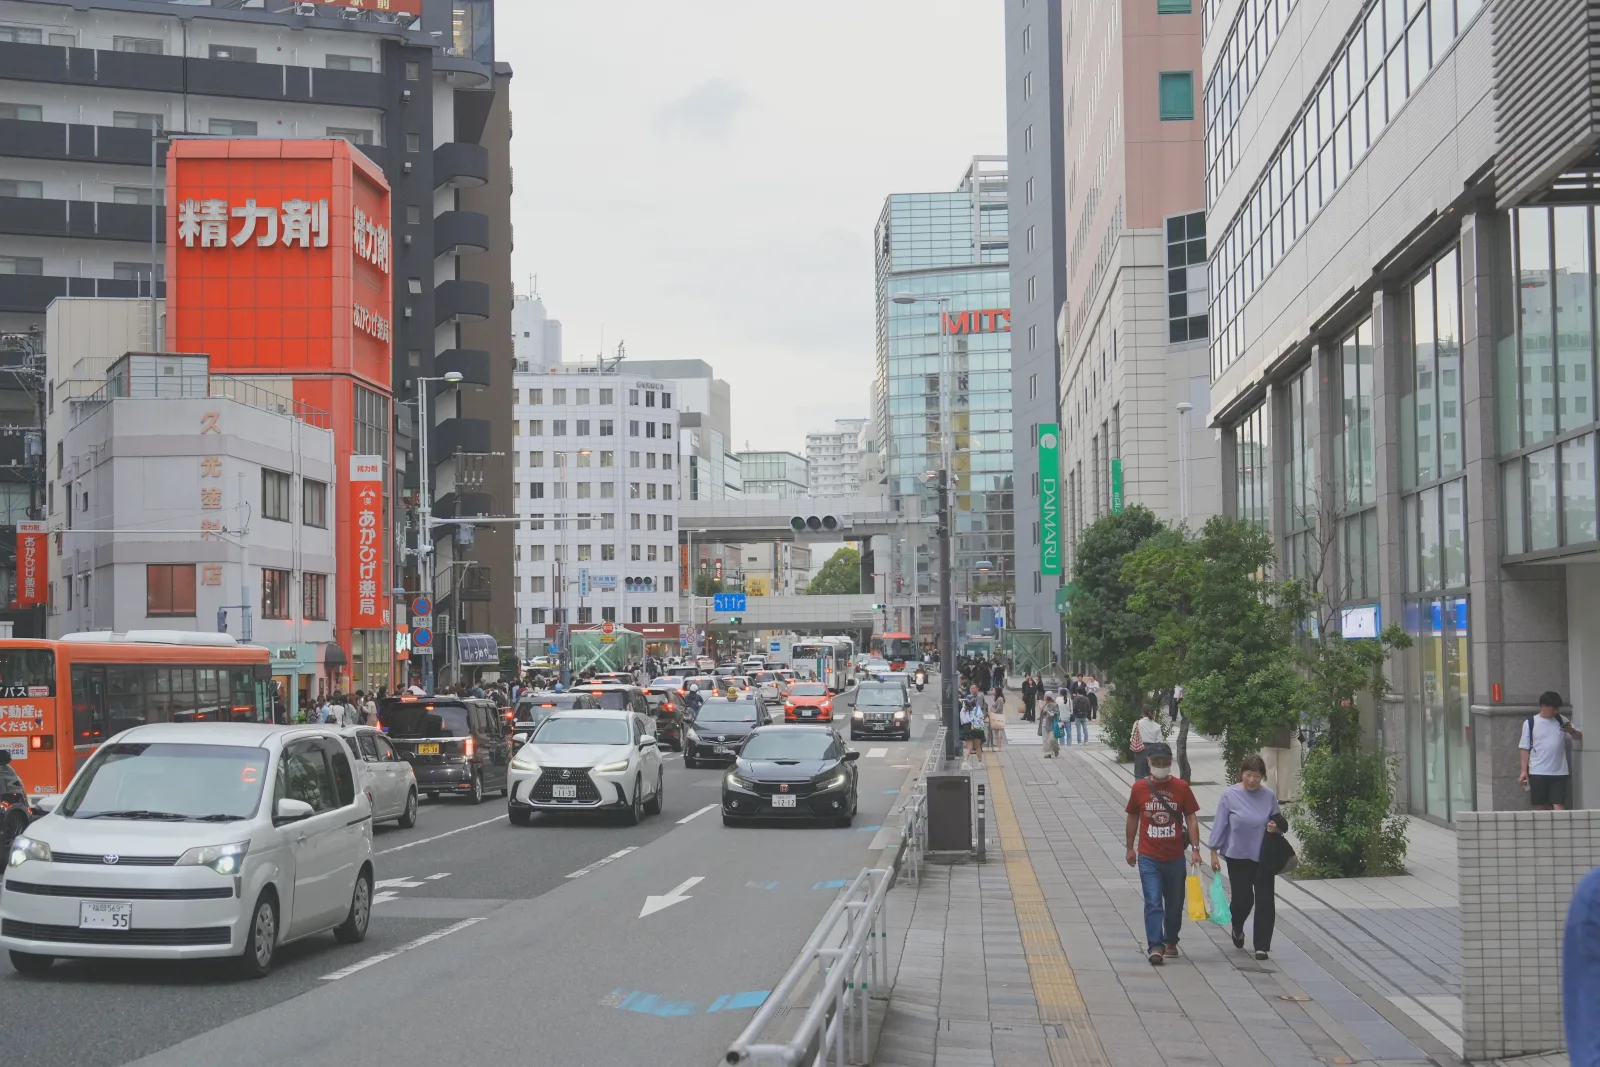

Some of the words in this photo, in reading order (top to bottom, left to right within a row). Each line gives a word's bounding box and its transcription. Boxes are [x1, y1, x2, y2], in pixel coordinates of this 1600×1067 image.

[178, 198, 329, 248] 精力剤
[353, 205, 389, 274] 精力剤
[357, 465, 378, 473] 精力剤
[1043, 478, 1057, 569] DAIMARU
[24, 536, 36, 598] あかひげ薬局
[358, 509, 377, 616] あかひげ薬局
[777, 799, 795, 807] 12-12
[1147, 822, 1176, 838] 49ERS
[112, 914, 128, 927] 55
